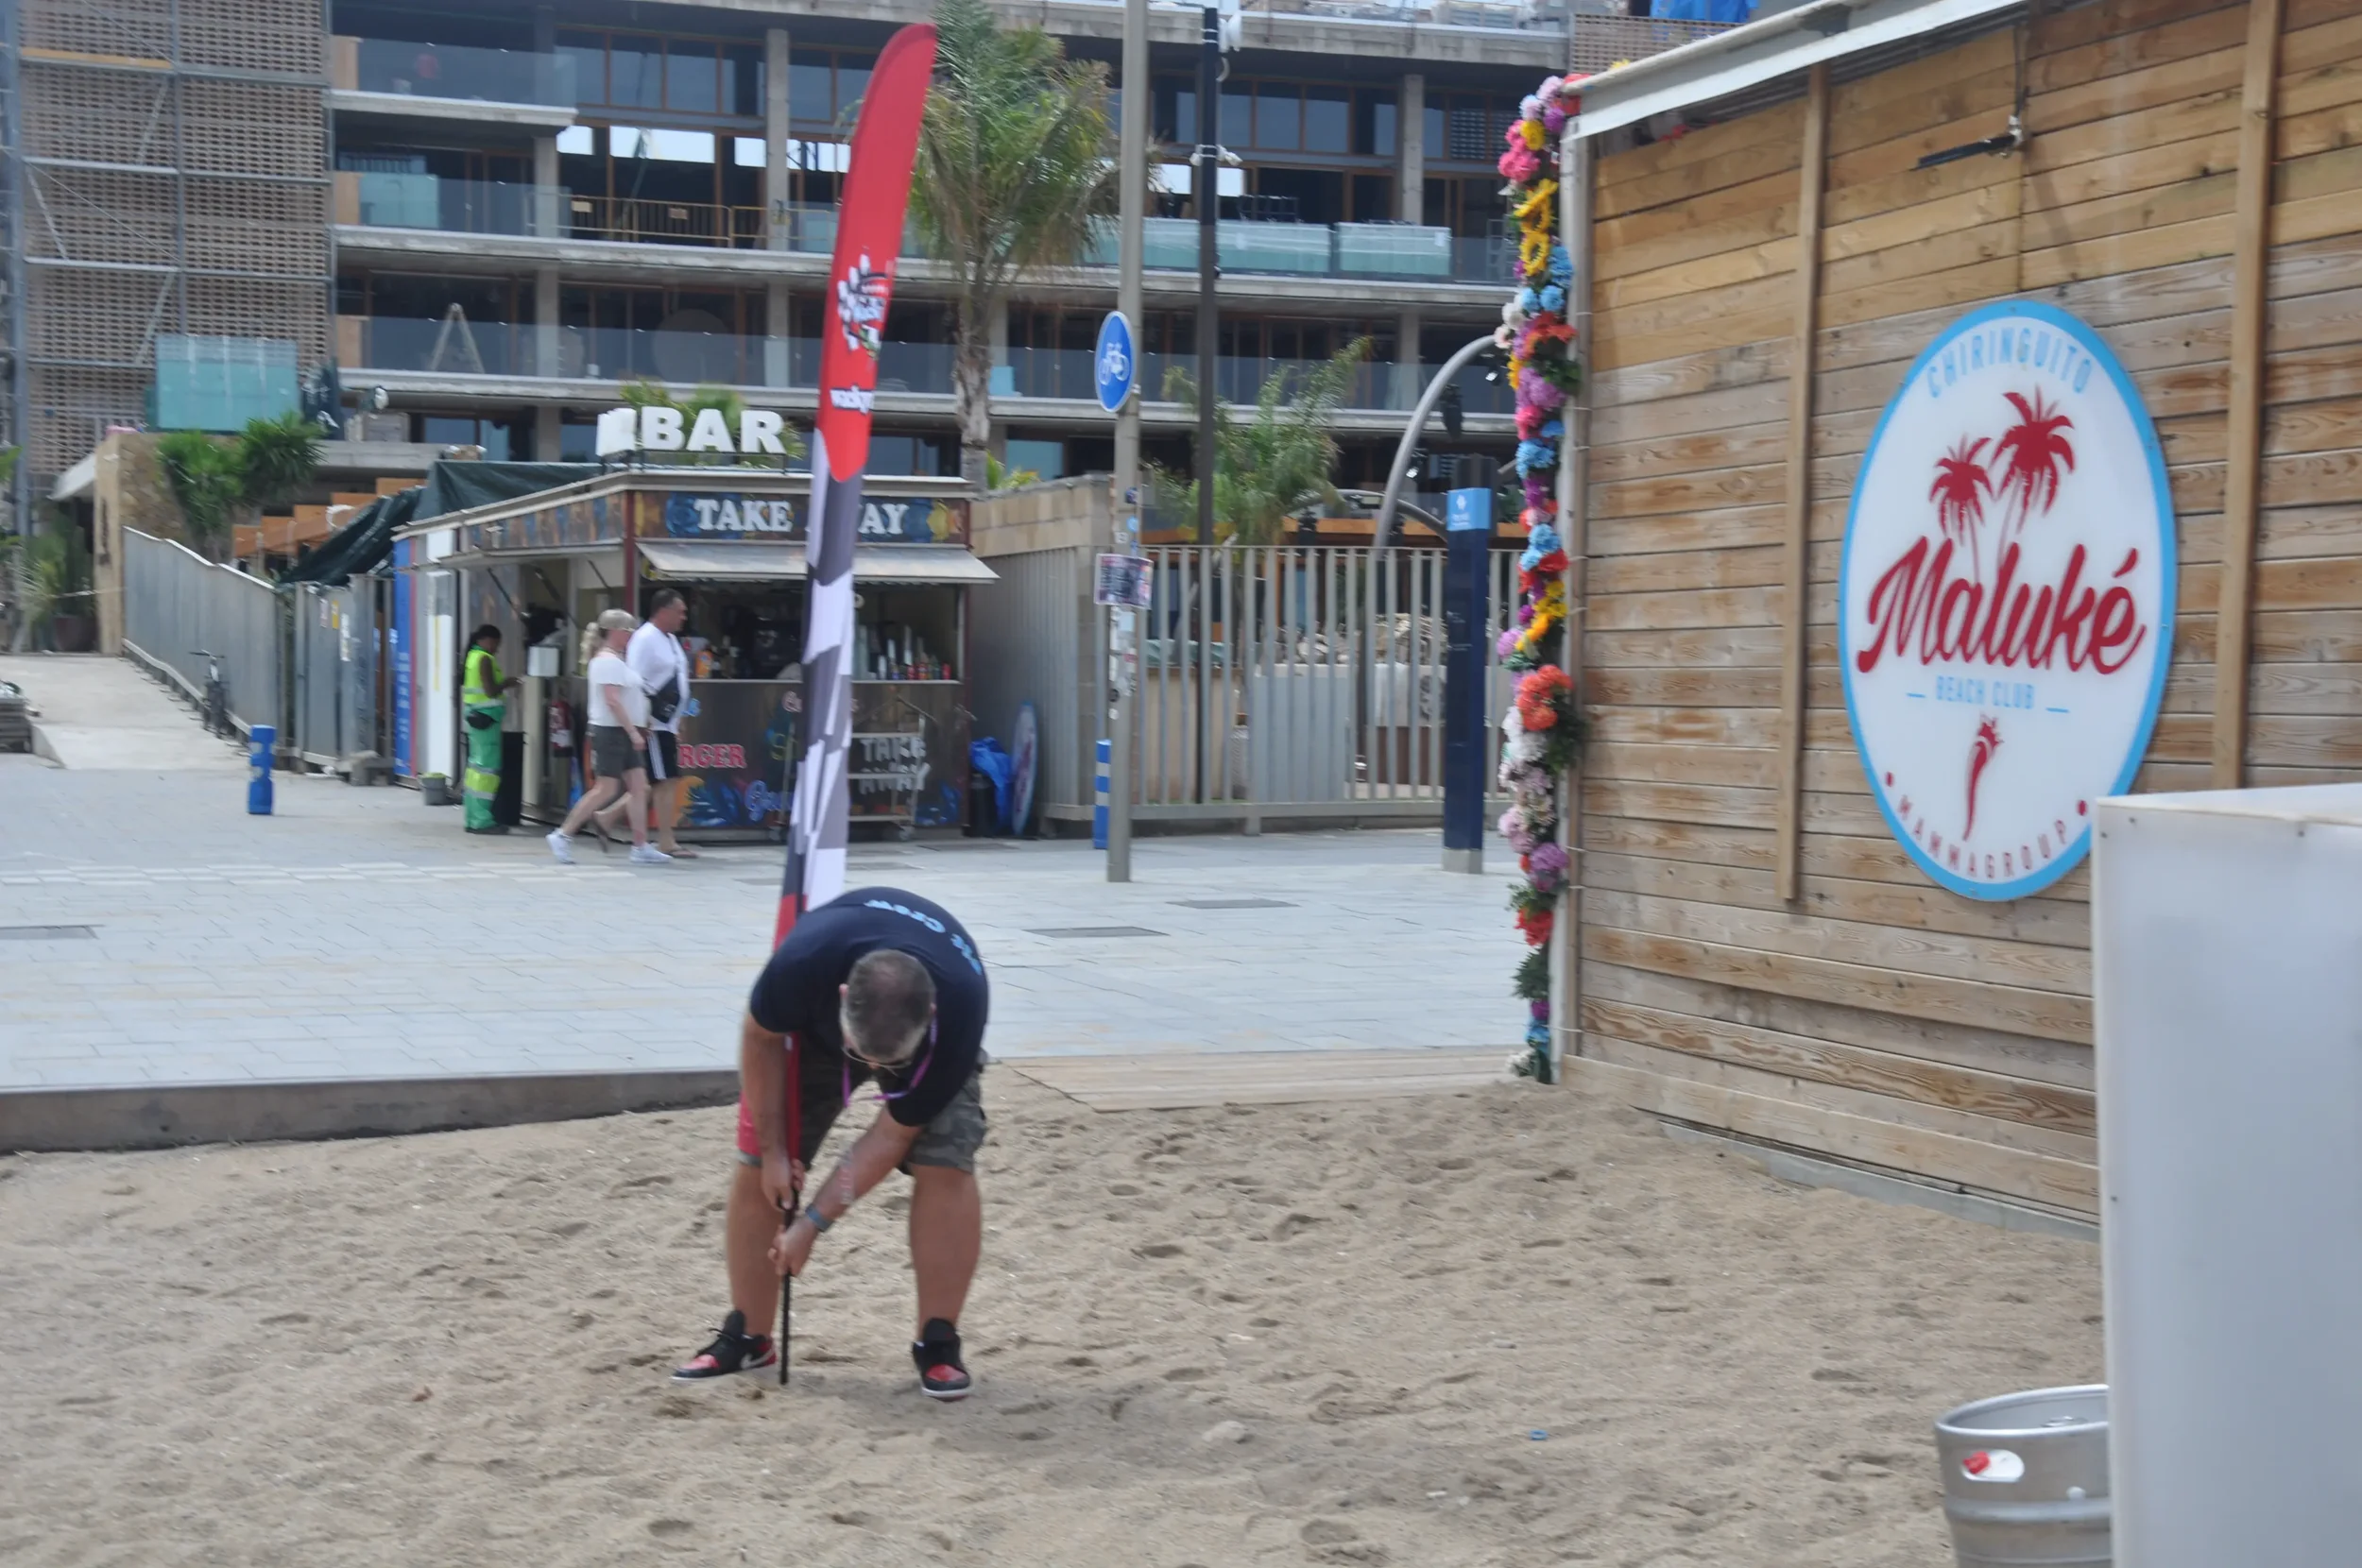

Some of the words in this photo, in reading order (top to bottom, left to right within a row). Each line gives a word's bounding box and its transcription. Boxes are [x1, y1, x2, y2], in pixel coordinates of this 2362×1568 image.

[1926, 327, 2093, 399] CHIRINGUITO
[642, 405, 787, 454] BAR
[693, 499, 793, 533] TAKE
[805, 503, 910, 535] AY
[1857, 536, 2148, 675] Maluké
[1937, 675, 1984, 705] BEACH
[1993, 681, 2036, 709] CLUB
[676, 743, 747, 769] RGER
[859, 737, 927, 762] TAKE
[1898, 794, 2066, 879] MAMMAGROUP
